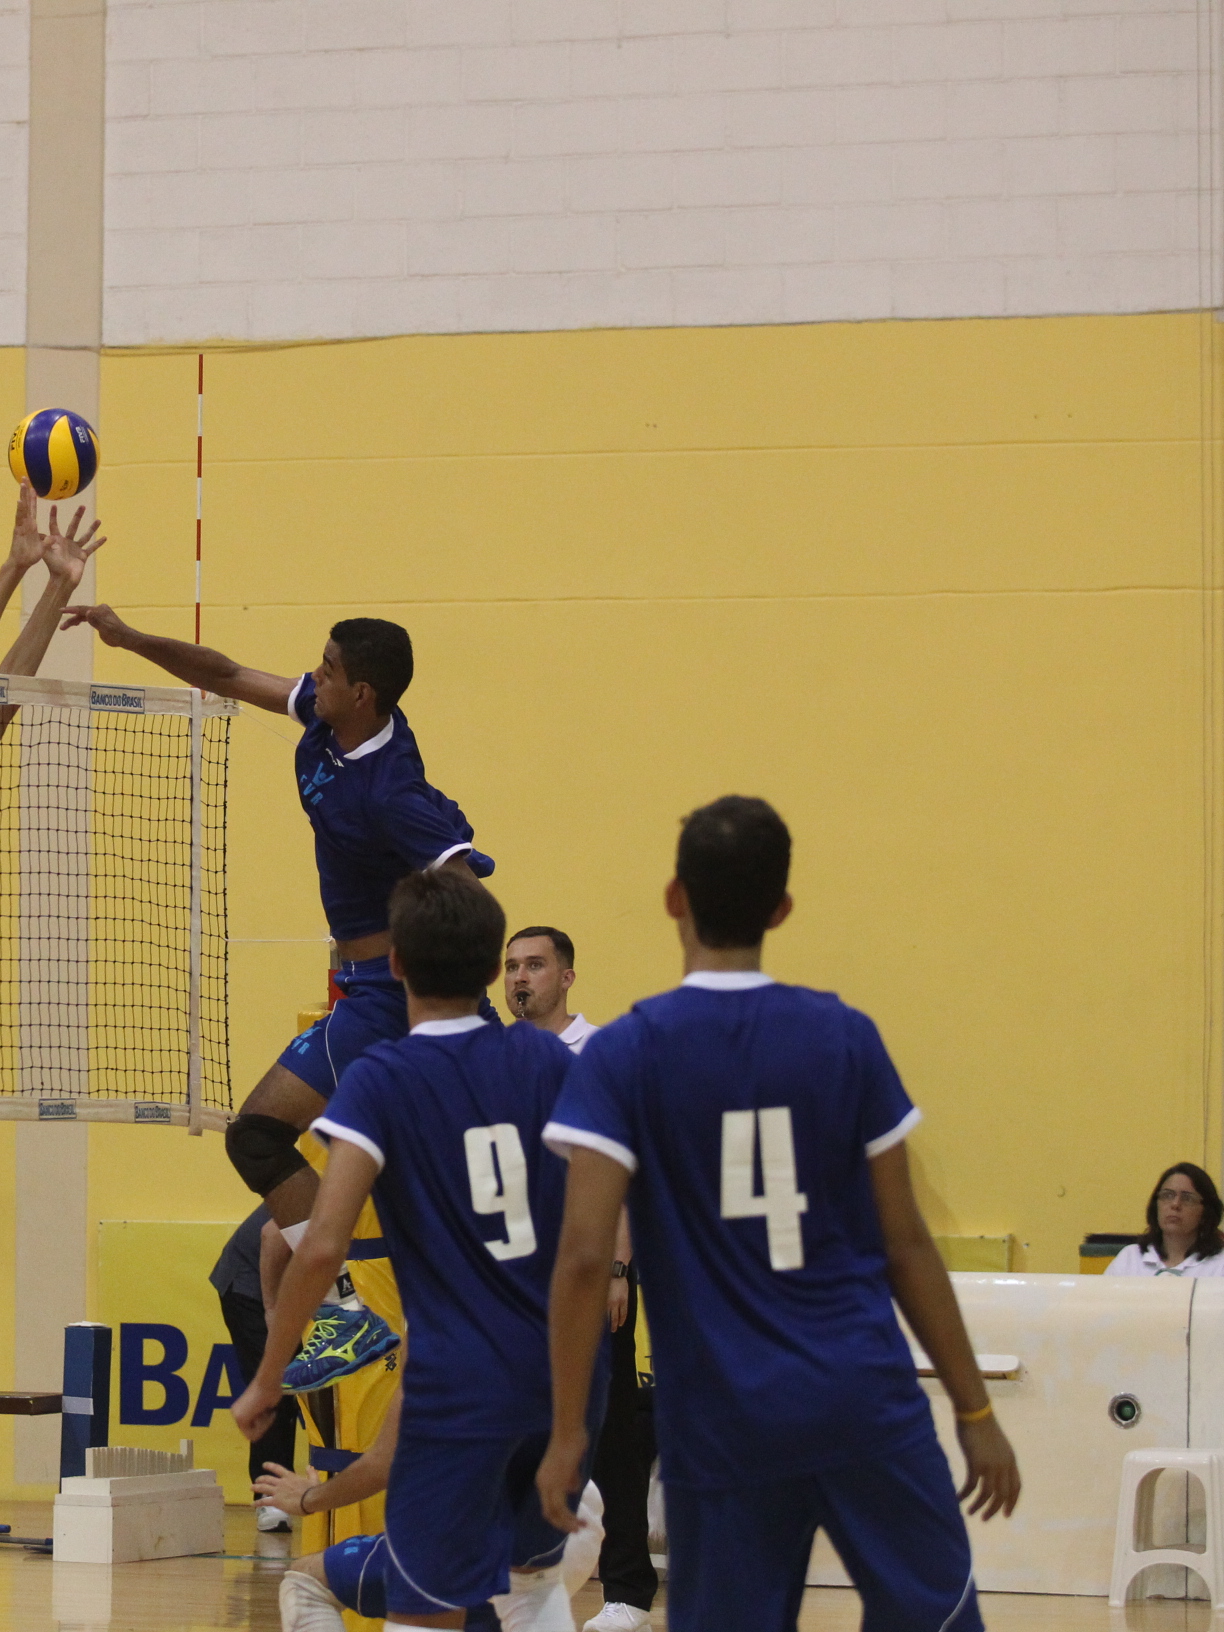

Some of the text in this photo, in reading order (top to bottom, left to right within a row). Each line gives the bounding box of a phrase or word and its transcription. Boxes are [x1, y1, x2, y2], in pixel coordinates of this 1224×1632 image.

[464, 1123, 538, 1261] 9
[720, 1106, 809, 1271] 4
[119, 1323, 254, 1427] BA
